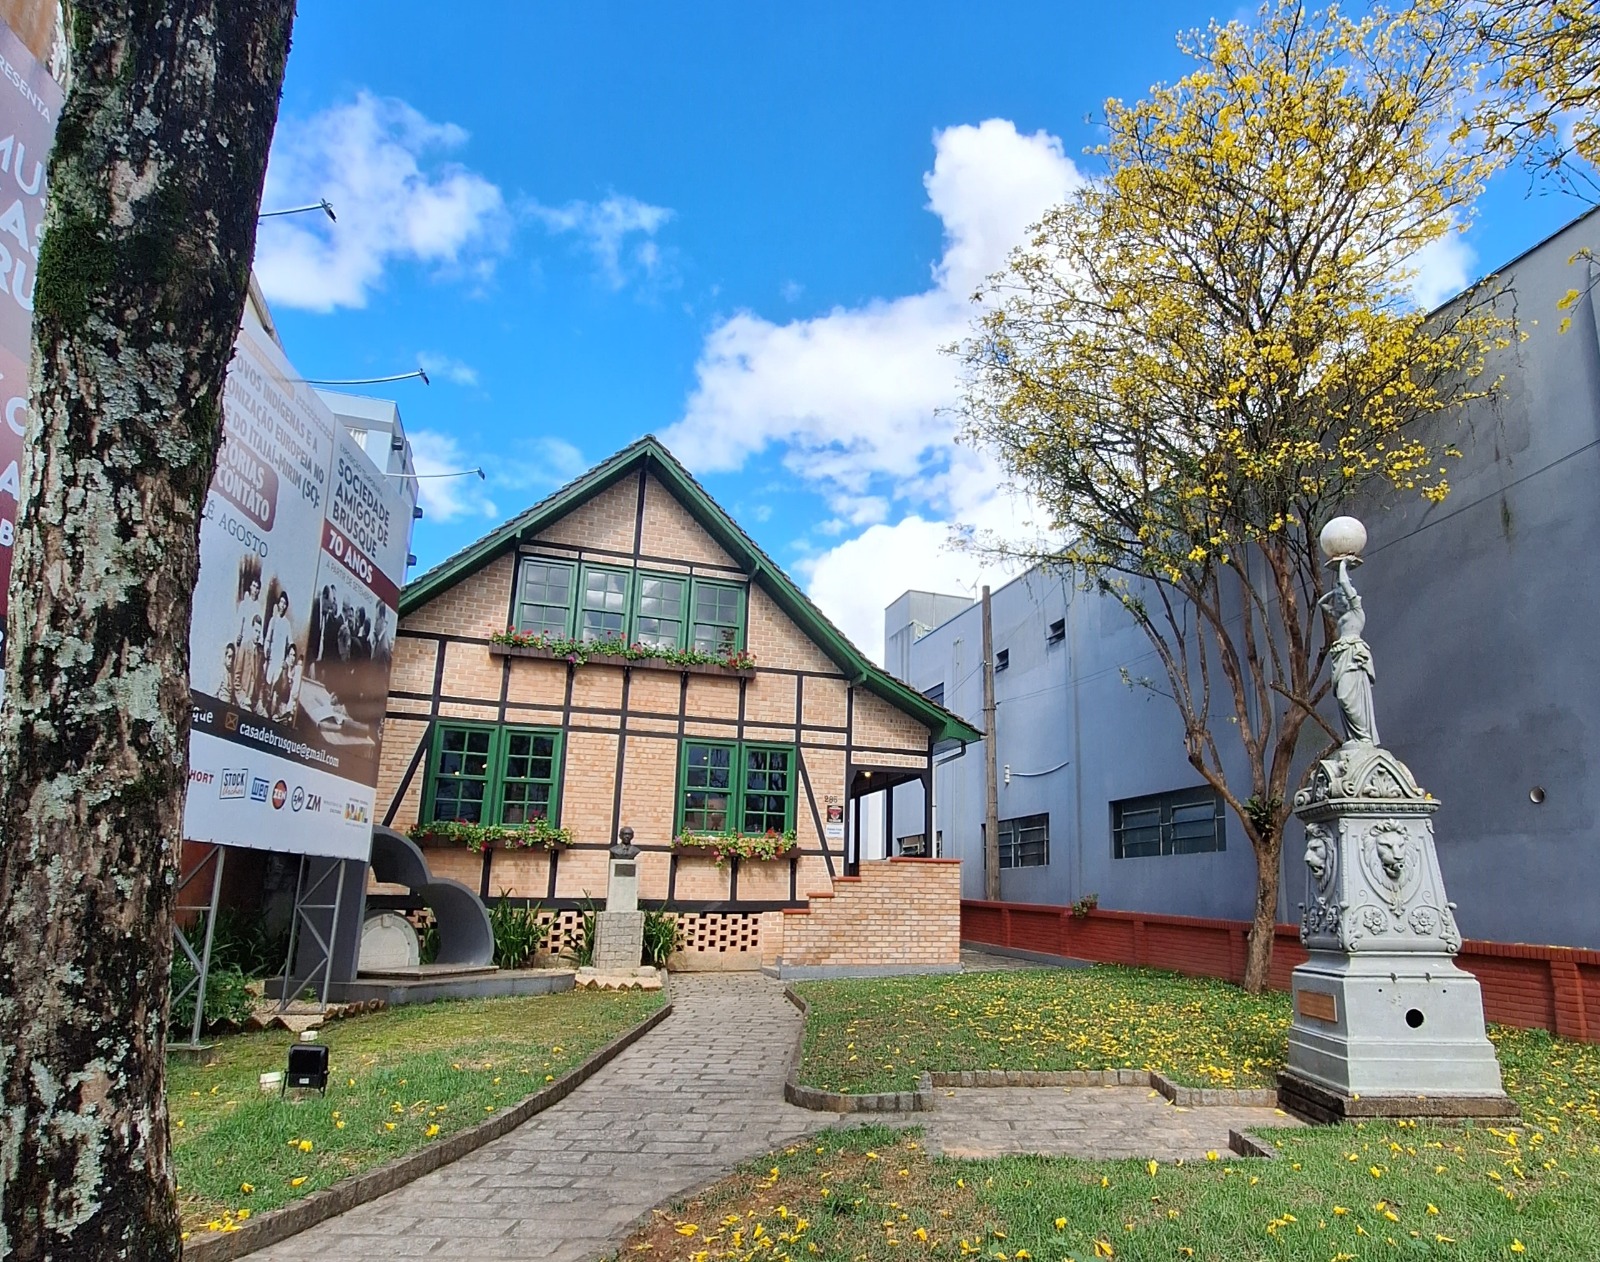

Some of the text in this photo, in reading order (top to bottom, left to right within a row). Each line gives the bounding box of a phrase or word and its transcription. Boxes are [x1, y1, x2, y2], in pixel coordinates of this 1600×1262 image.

[233, 411, 248, 437] DO
[263, 382, 306, 439] INDÍGENAS
[306, 428, 313, 447] E
[312, 437, 319, 454] A
[275, 423, 313, 475] EUROPEIA
[314, 462, 325, 484] NO
[335, 481, 389, 548] AMIGOS DE
[337, 457, 390, 527] SOCIEDADE
[218, 512, 269, 558] AGOSTO
[328, 529, 374, 584] 70 ANOS
[332, 500, 377, 559] BRUSQUE
[239, 722, 340, 768] casadebrusque@gmail.com
[224, 773, 246, 787] STOCK
[305, 793, 321, 812] ZM
